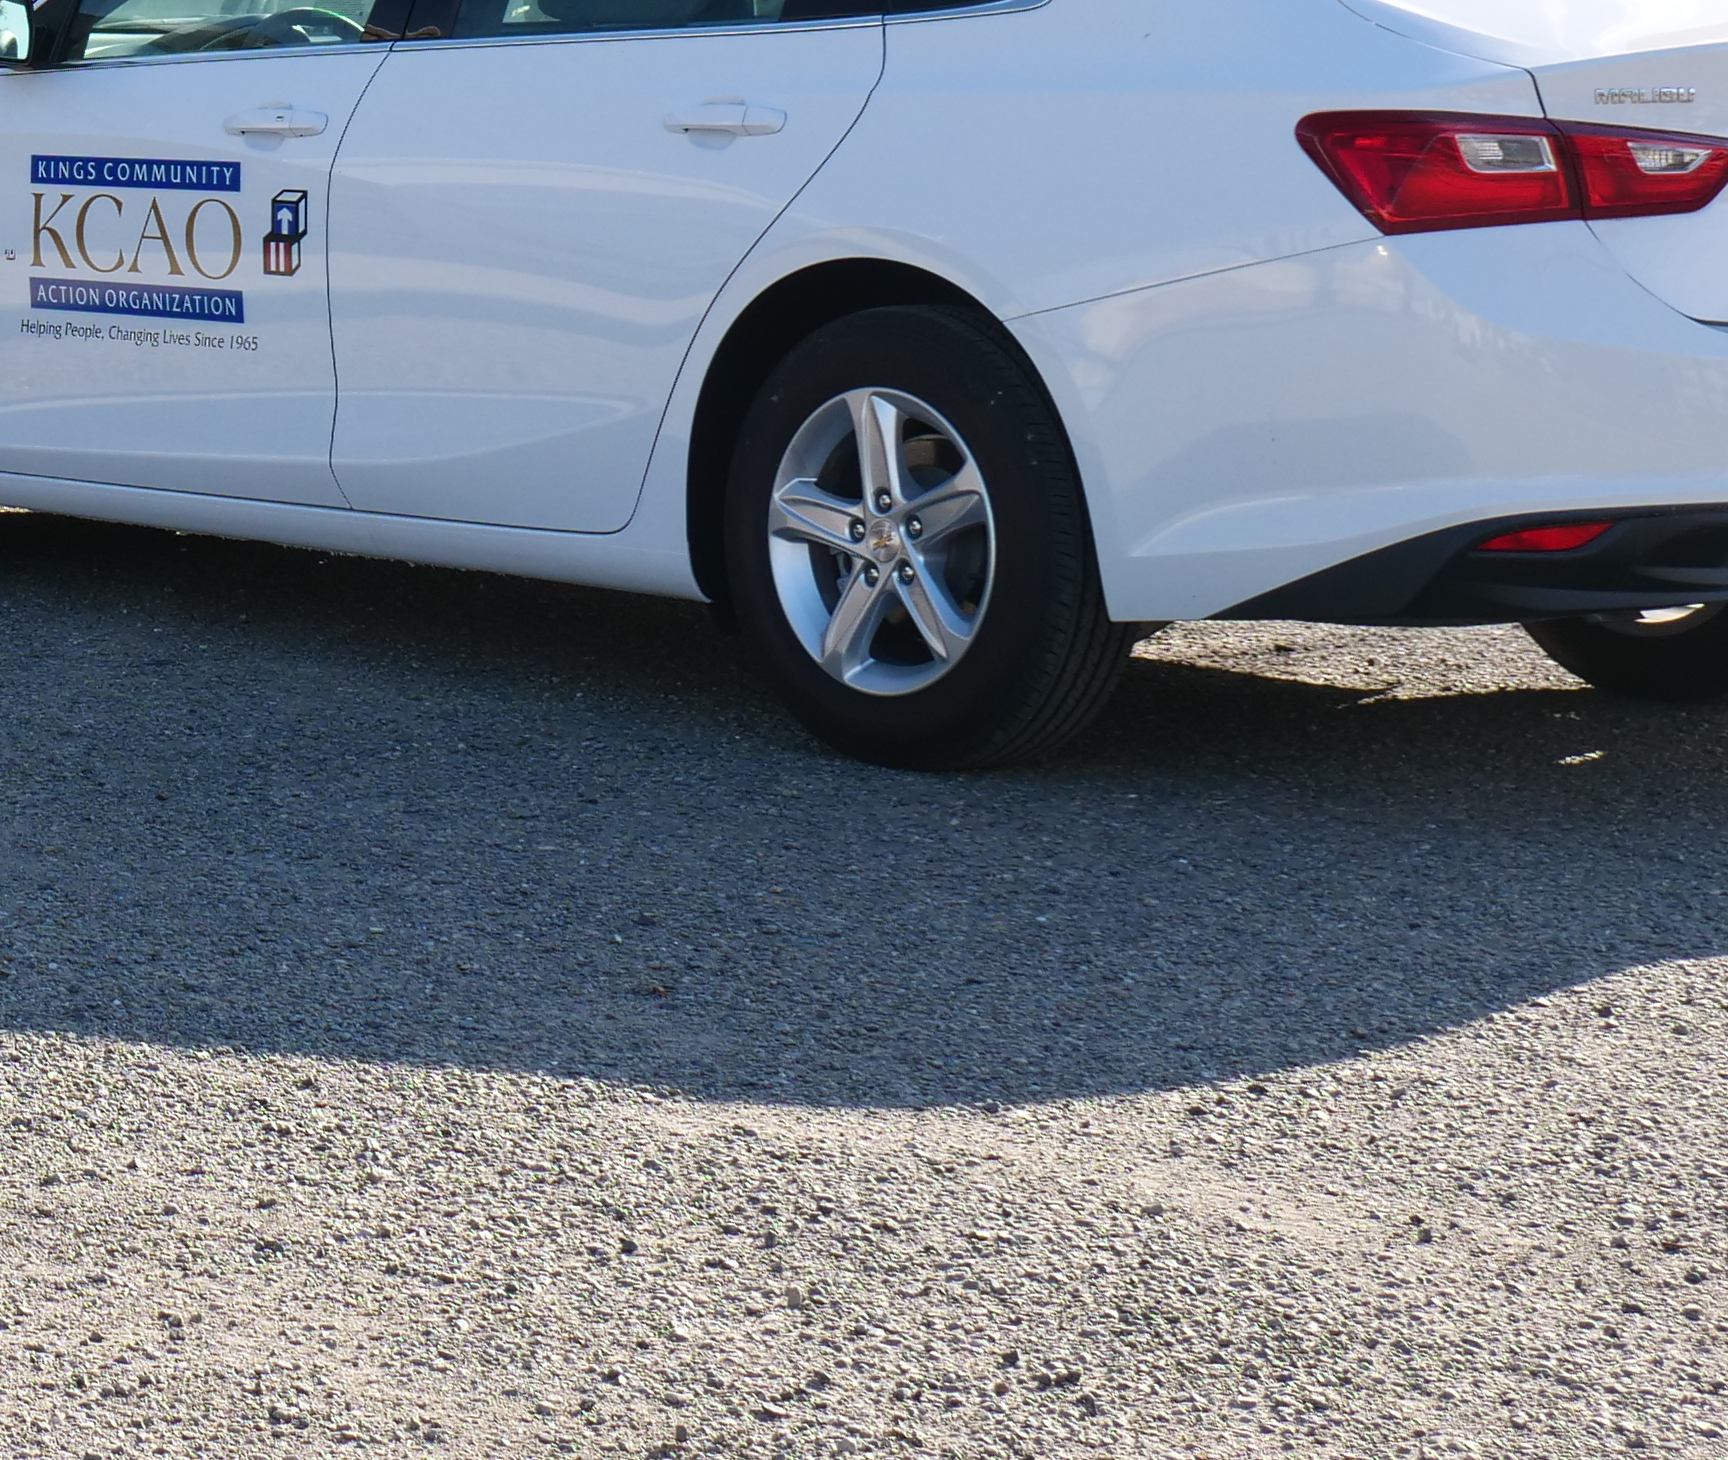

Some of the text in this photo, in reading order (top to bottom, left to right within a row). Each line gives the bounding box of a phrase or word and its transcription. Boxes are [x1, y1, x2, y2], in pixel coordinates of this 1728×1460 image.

[1595, 87, 1696, 104] MALIBU
[38, 160, 234, 185] KINGS COMMUNITY
[29, 192, 242, 280] KCAO
[37, 284, 237, 317] ACTION ORGANIZATION
[20, 319, 259, 351] Helping People, Changing Lives Since 1965
